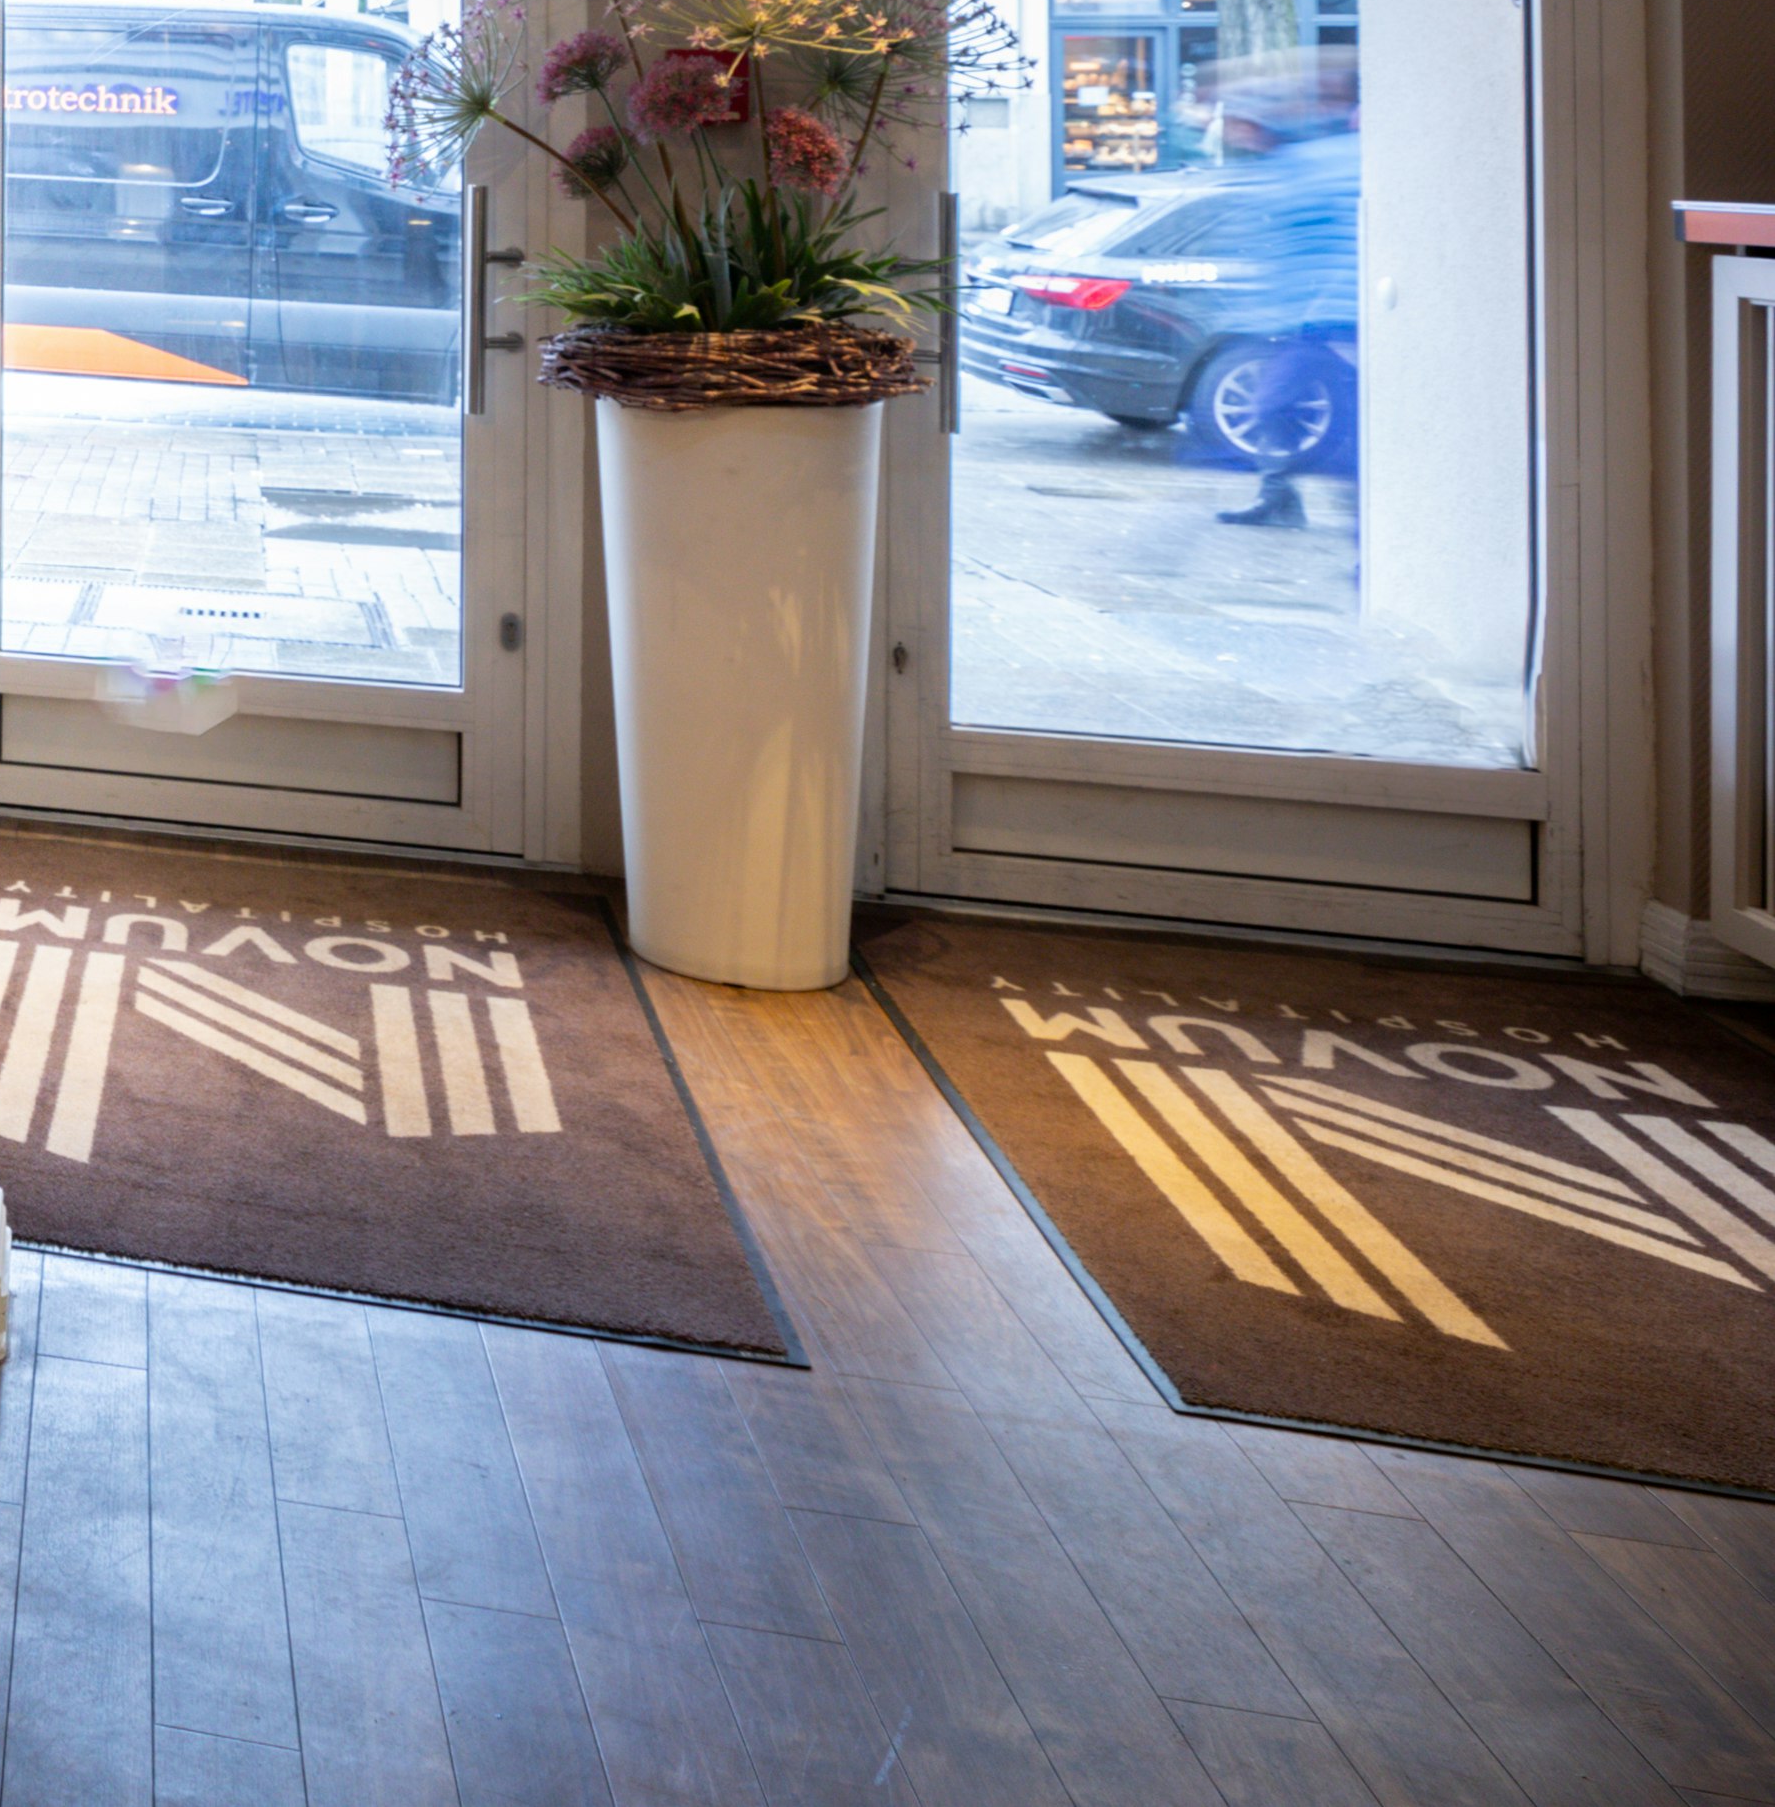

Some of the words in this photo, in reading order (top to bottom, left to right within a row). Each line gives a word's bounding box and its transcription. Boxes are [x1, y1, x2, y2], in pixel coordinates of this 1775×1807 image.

[4, 880, 509, 944] HOSPITALITY
[990, 976, 1630, 1052] HOSPITALITY
[999, 998, 1720, 1109] NOVUM
